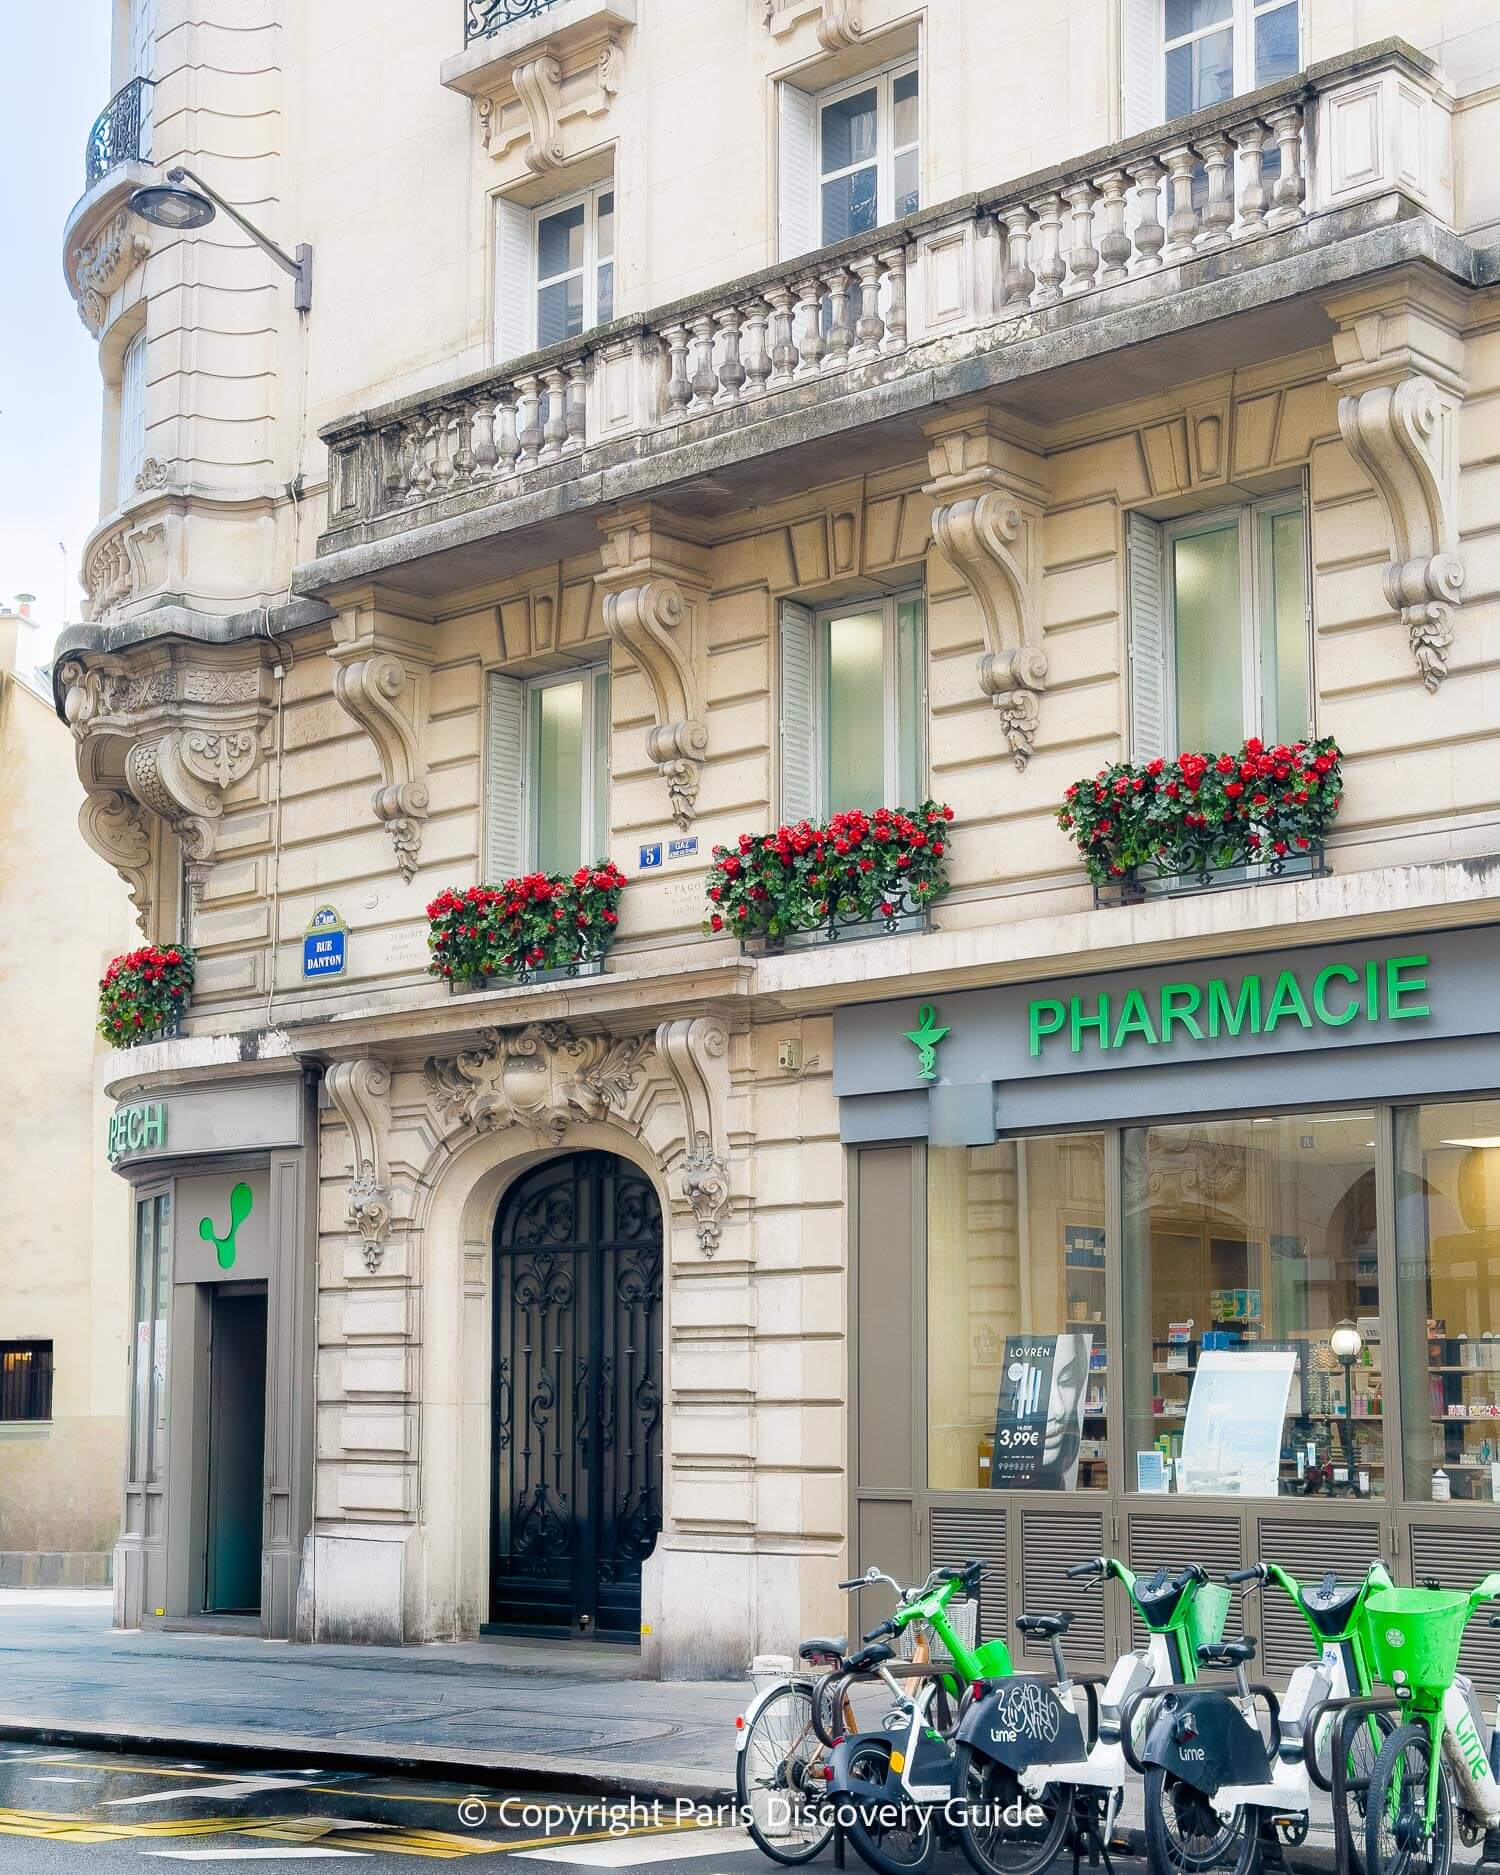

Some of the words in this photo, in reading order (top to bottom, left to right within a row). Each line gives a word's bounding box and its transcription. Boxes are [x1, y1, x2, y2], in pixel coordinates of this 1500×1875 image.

[676, 840, 690, 849] GAZ
[646, 847, 654, 864] 5
[316, 940, 333, 953] RUE
[307, 954, 342, 969] DANTON
[1028, 954, 1431, 1056] PHARMACIE
[1010, 1345, 1050, 1358] LOVRÉN
[1000, 1428, 1040, 1449] 3,99€
[990, 1729, 1017, 1742] Lime
[1456, 1711, 1488, 1781] Lime
[1179, 1747, 1205, 1761] Lime
